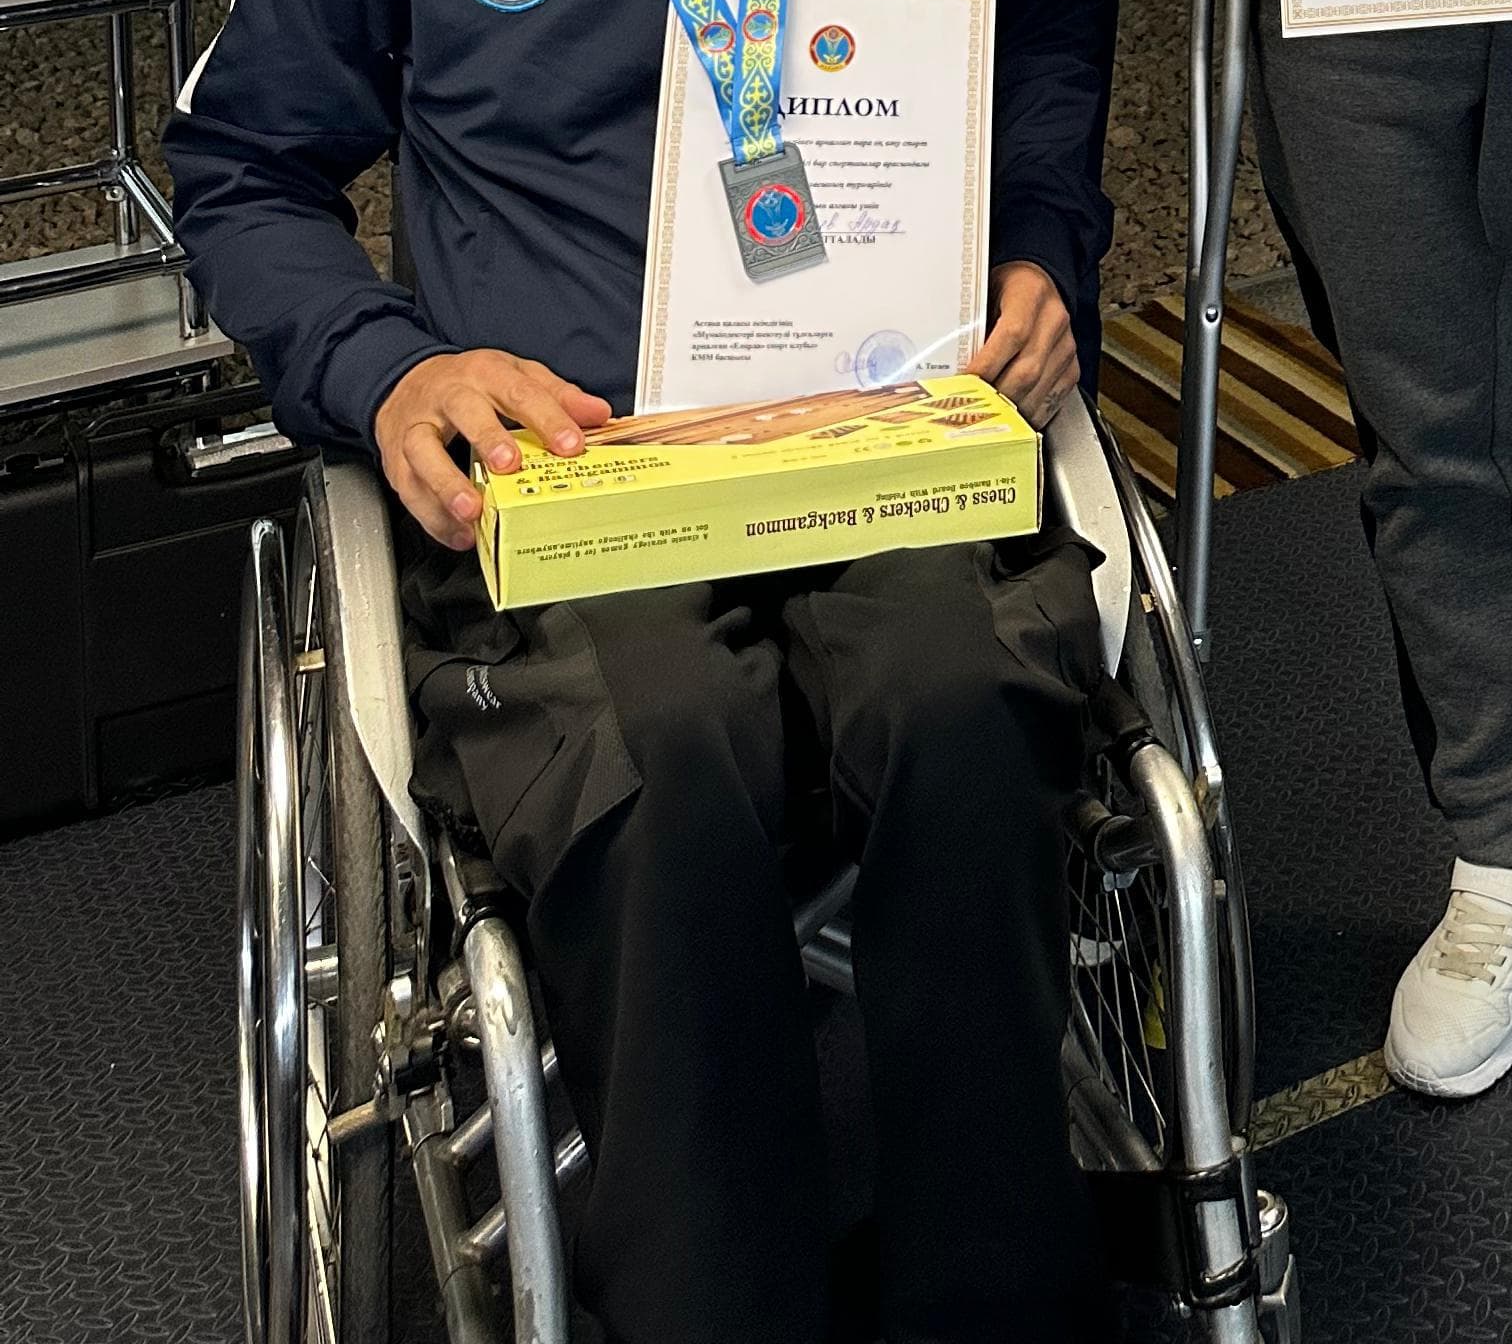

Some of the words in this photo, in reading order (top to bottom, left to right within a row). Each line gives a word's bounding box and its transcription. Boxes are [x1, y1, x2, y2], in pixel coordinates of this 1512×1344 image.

[778, 96, 900, 120] ИПЛОМ
[954, 494, 968, 512] &
[972, 486, 1016, 505] Chess
[862, 508, 876, 524] &
[879, 496, 950, 519] Checkers
[746, 508, 858, 537] Backgammon
